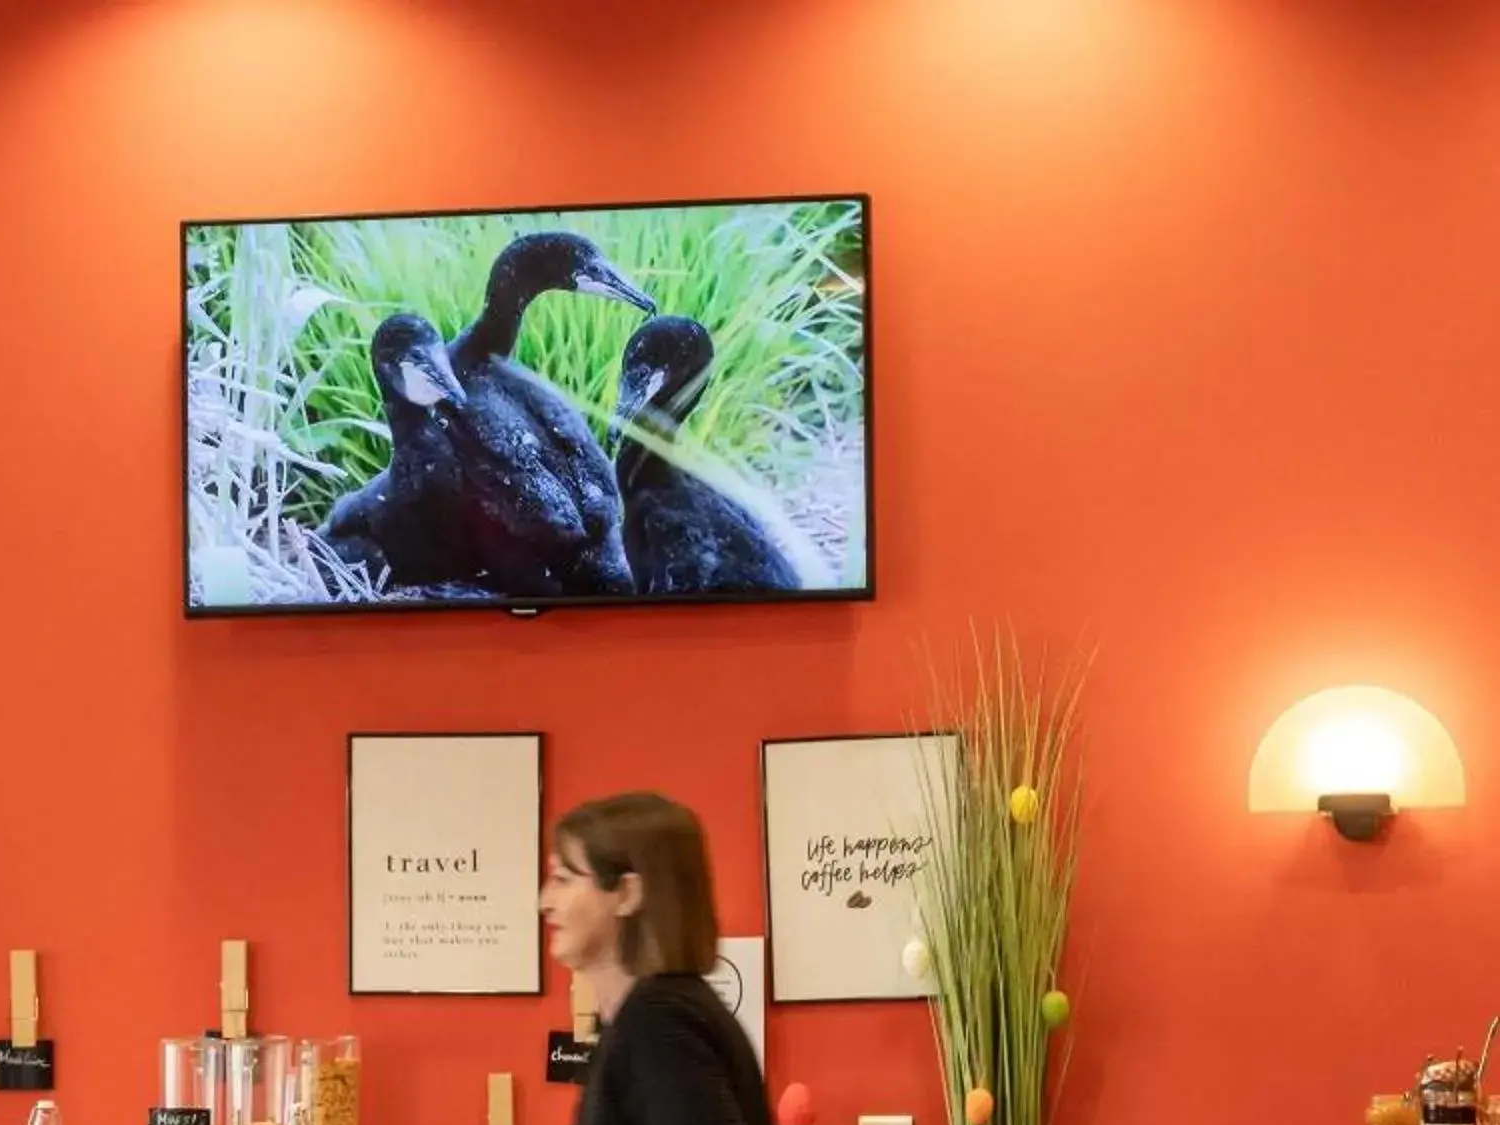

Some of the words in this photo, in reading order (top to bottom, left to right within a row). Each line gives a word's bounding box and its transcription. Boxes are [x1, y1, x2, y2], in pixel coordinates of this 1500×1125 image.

[843, 835, 932, 859] happens
[387, 848, 479, 873] travel
[801, 859, 852, 896] coffee
[860, 859, 929, 887] helps
